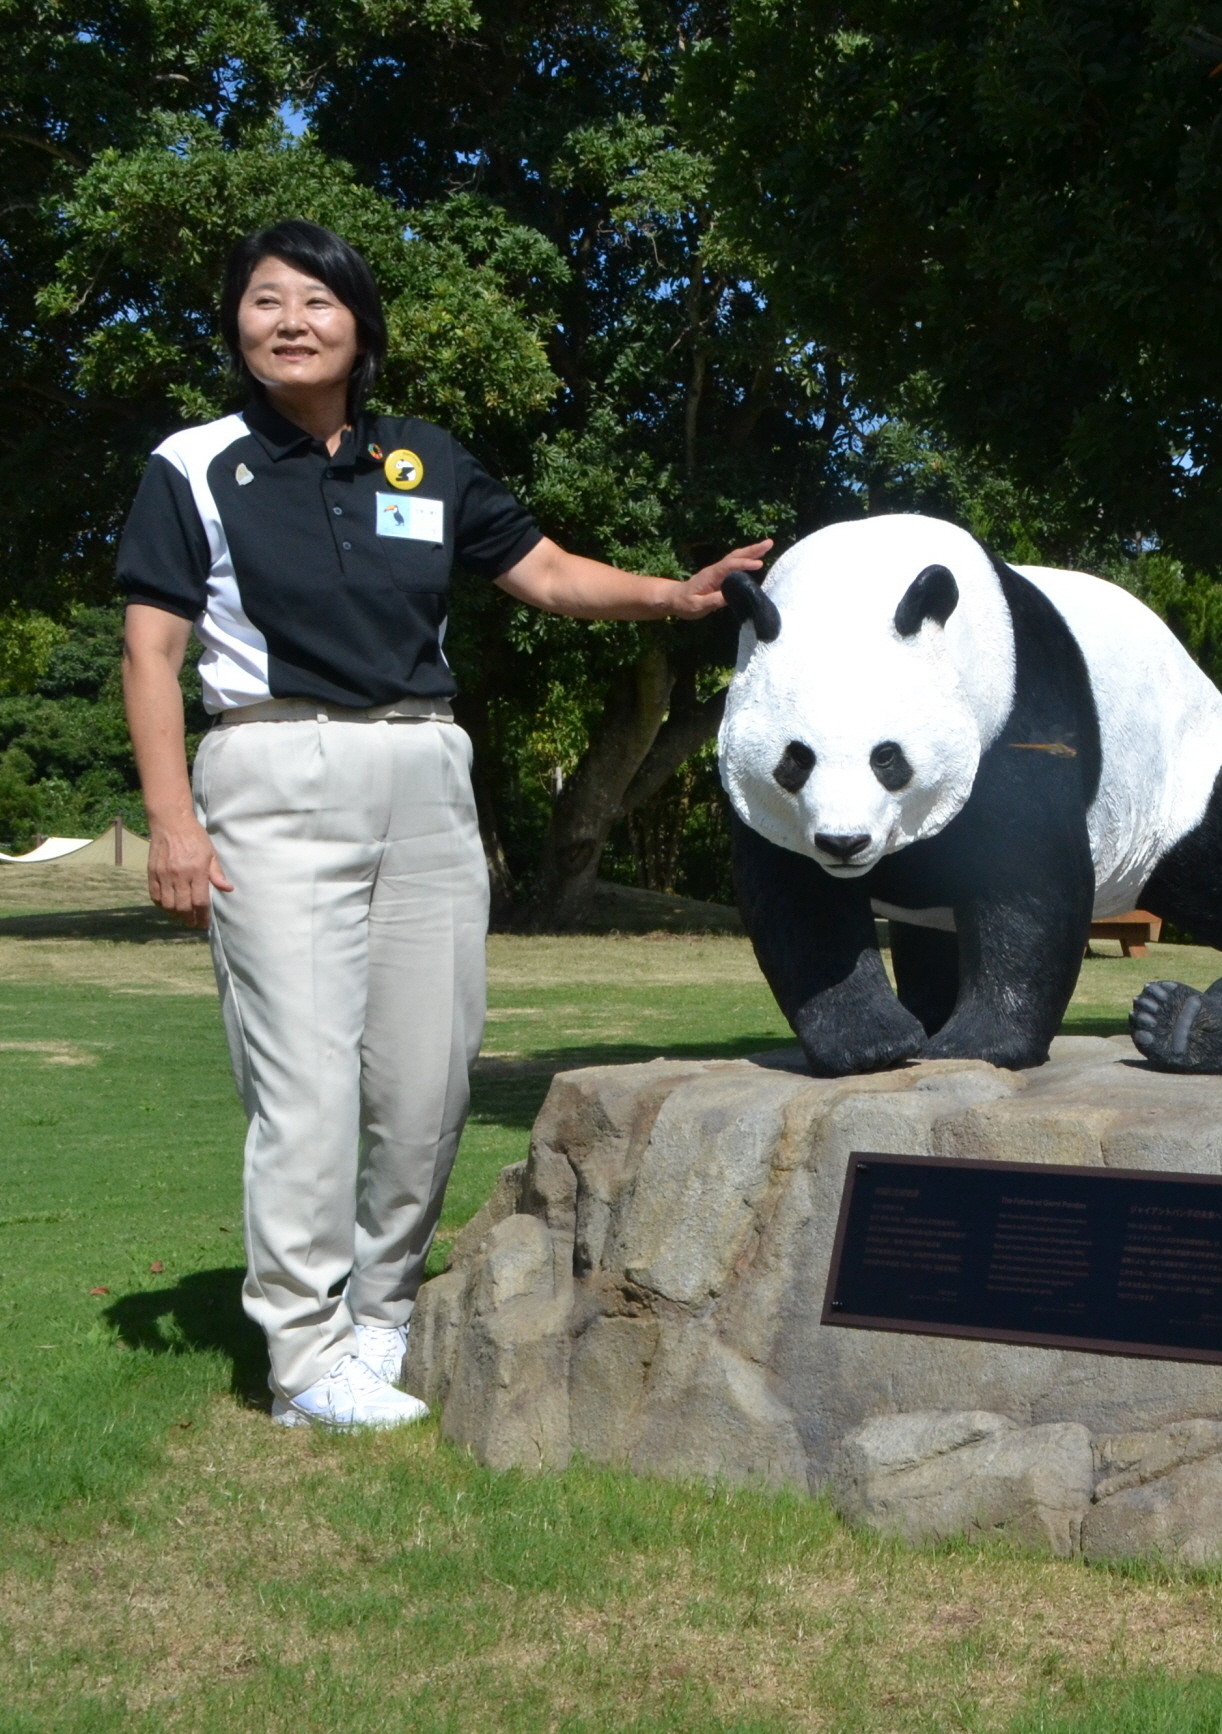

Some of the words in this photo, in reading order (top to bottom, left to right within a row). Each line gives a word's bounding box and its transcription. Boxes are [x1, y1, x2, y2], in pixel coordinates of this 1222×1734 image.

[1001, 1196, 1013, 1204] The
[1014, 1197, 1034, 1206] Future
[1034, 1198, 1043, 1206] of
[1043, 1199, 1061, 1208] Giant
[1062, 1200, 1087, 1210] Pandas
[1129, 1205, 1222, 1219] ジャイアントパンダの未来へ
